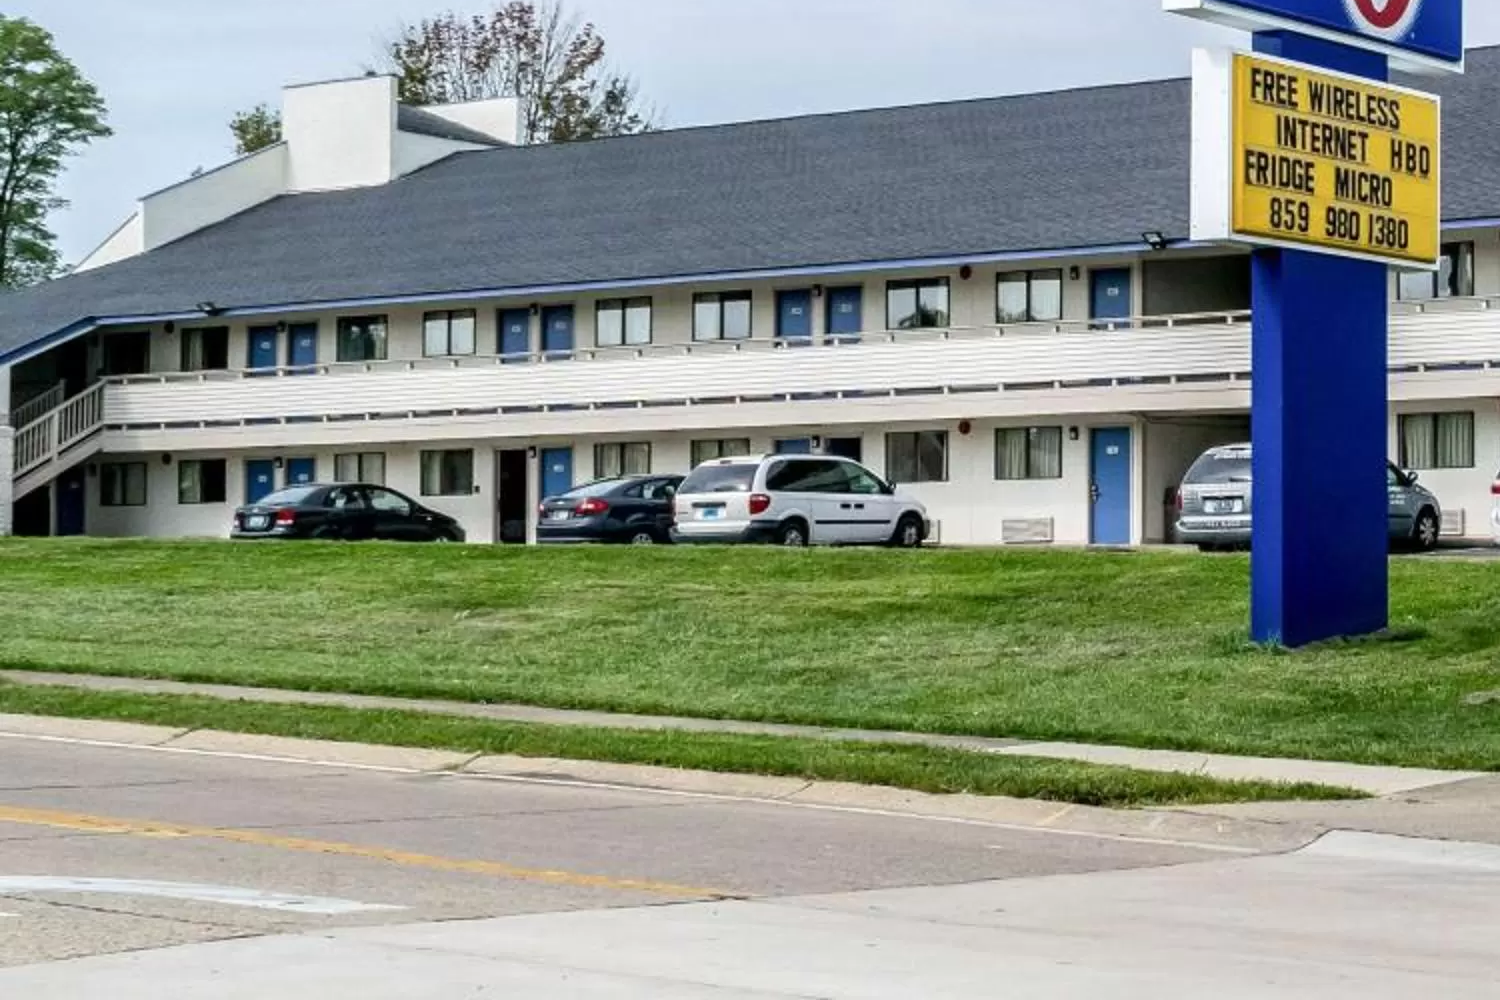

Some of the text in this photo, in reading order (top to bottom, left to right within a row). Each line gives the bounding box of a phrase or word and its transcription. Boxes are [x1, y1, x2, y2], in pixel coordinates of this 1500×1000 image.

[1251, 67, 1400, 131] FREE WIRELESS
[1276, 114, 1431, 177] INTERNET HBO
[1245, 148, 1393, 208] FRIDGE MICRO
[1269, 197, 1409, 249] 859 980 1380
